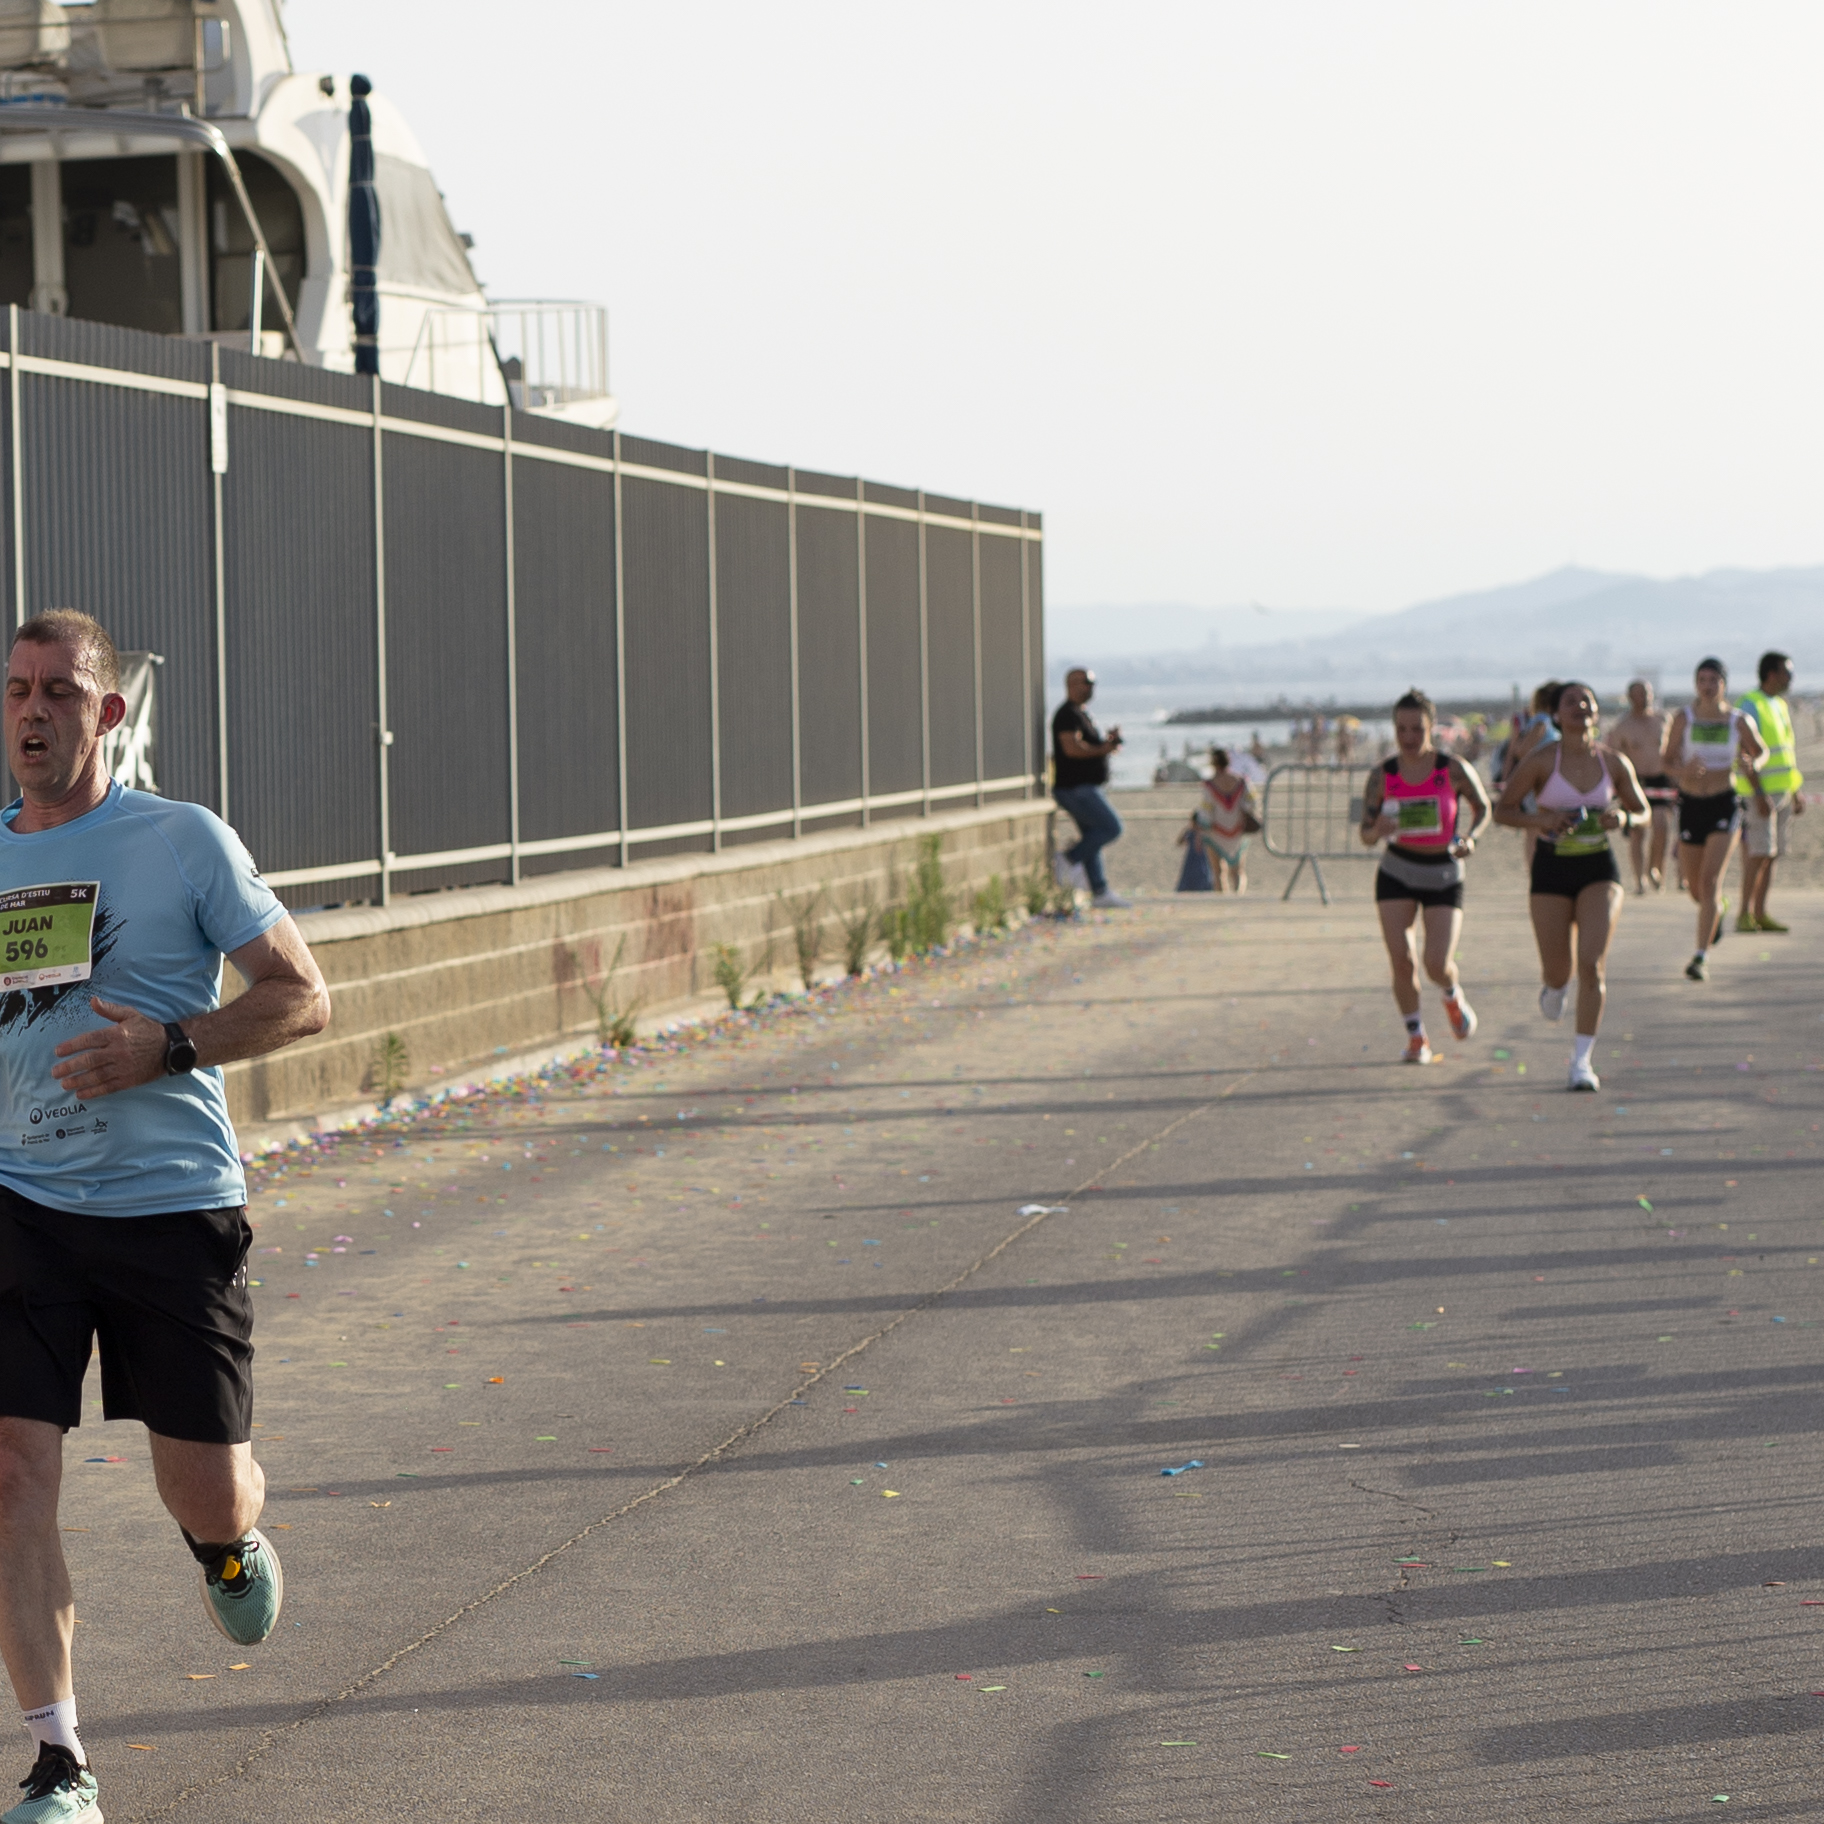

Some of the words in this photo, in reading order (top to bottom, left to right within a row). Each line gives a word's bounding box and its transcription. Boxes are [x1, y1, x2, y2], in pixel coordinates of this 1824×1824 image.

[70, 888, 87, 898] 5K
[2, 915, 53, 935] JUAN
[5, 938, 48, 962] 596
[45, 1103, 87, 1120] VEOLIA
